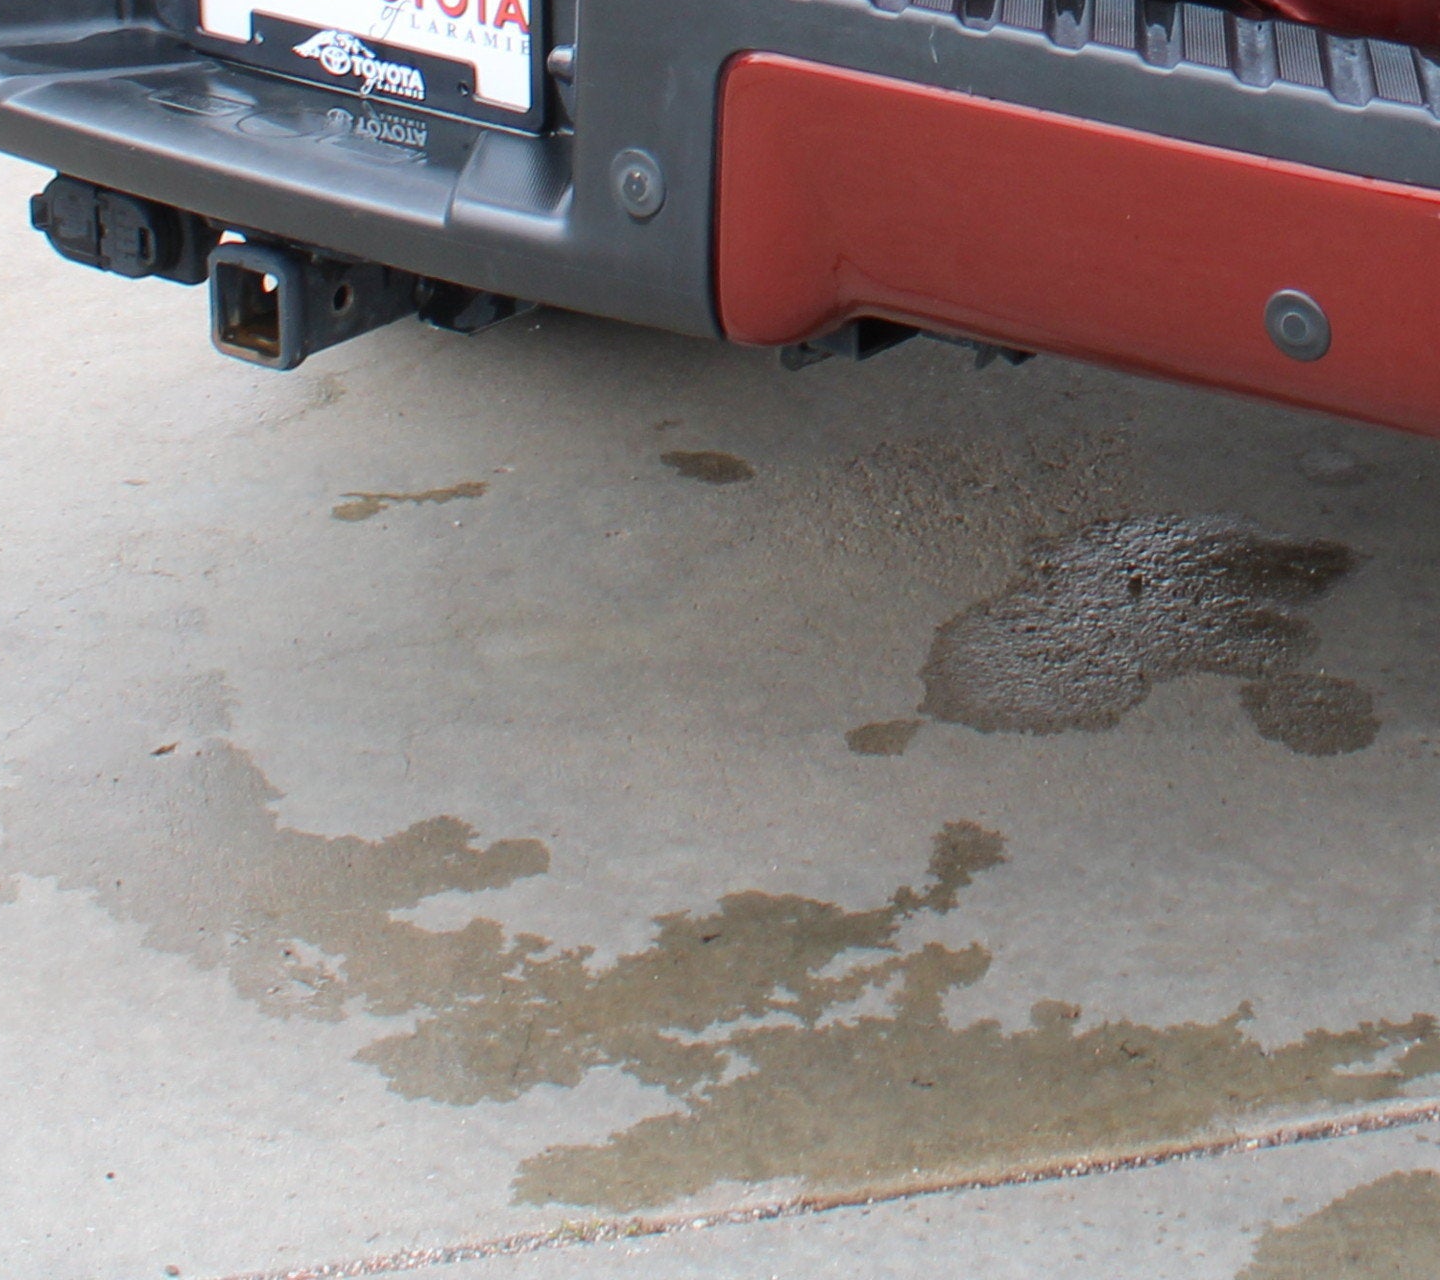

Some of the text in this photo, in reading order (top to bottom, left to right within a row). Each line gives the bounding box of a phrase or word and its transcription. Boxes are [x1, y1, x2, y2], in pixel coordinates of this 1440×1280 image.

[368, 0, 530, 56] of LARAMIE
[350, 55, 425, 93] TOYOTA
